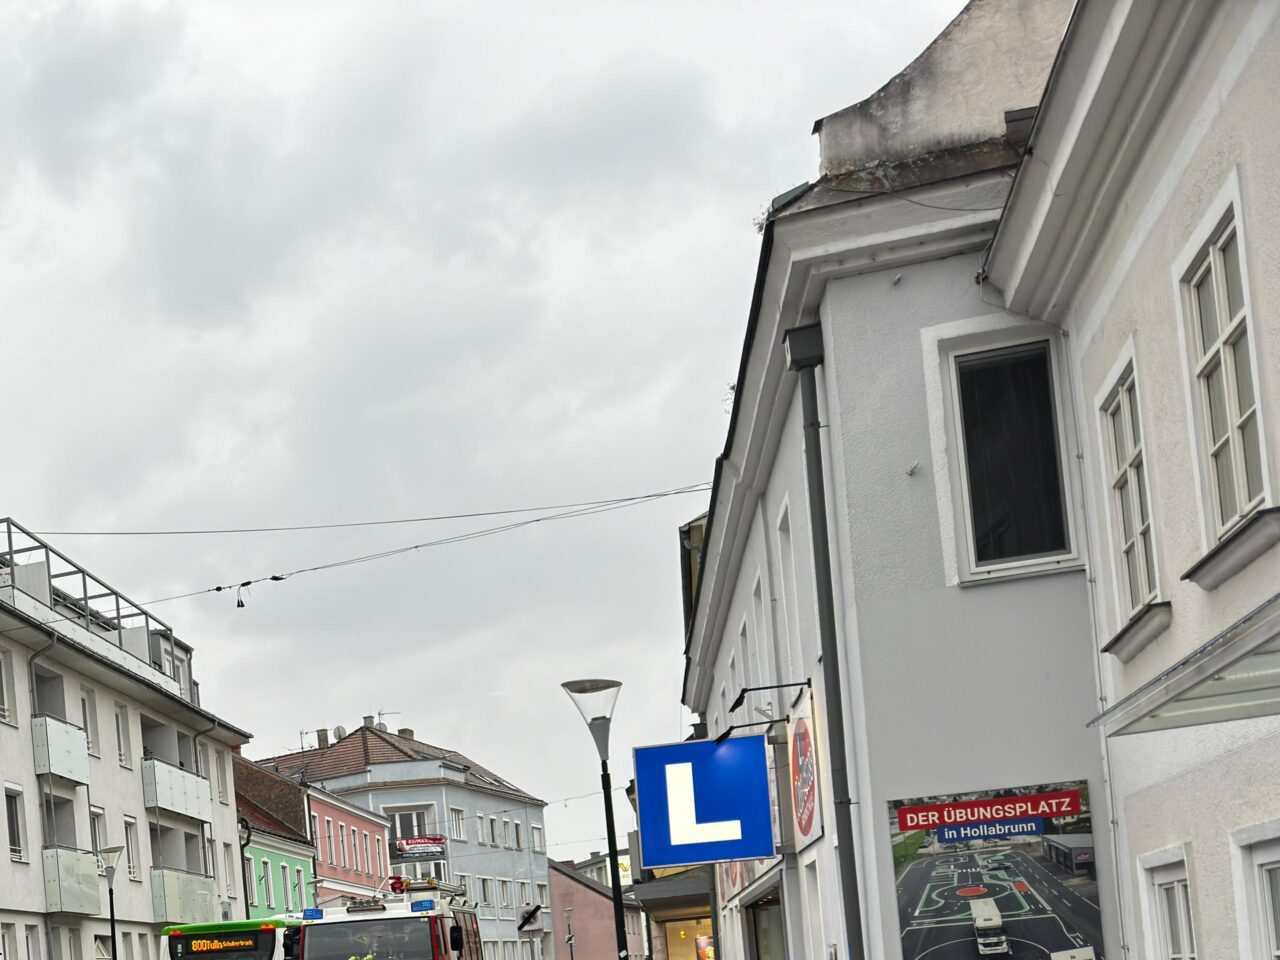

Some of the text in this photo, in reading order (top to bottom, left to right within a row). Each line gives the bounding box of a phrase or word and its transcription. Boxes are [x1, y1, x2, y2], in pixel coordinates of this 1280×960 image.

[664, 761, 743, 847] L
[906, 798, 1072, 827] DER ÜBUNGSPLATZ
[944, 821, 1036, 839] in Hollabrunn
[191, 940, 207, 952] 800
